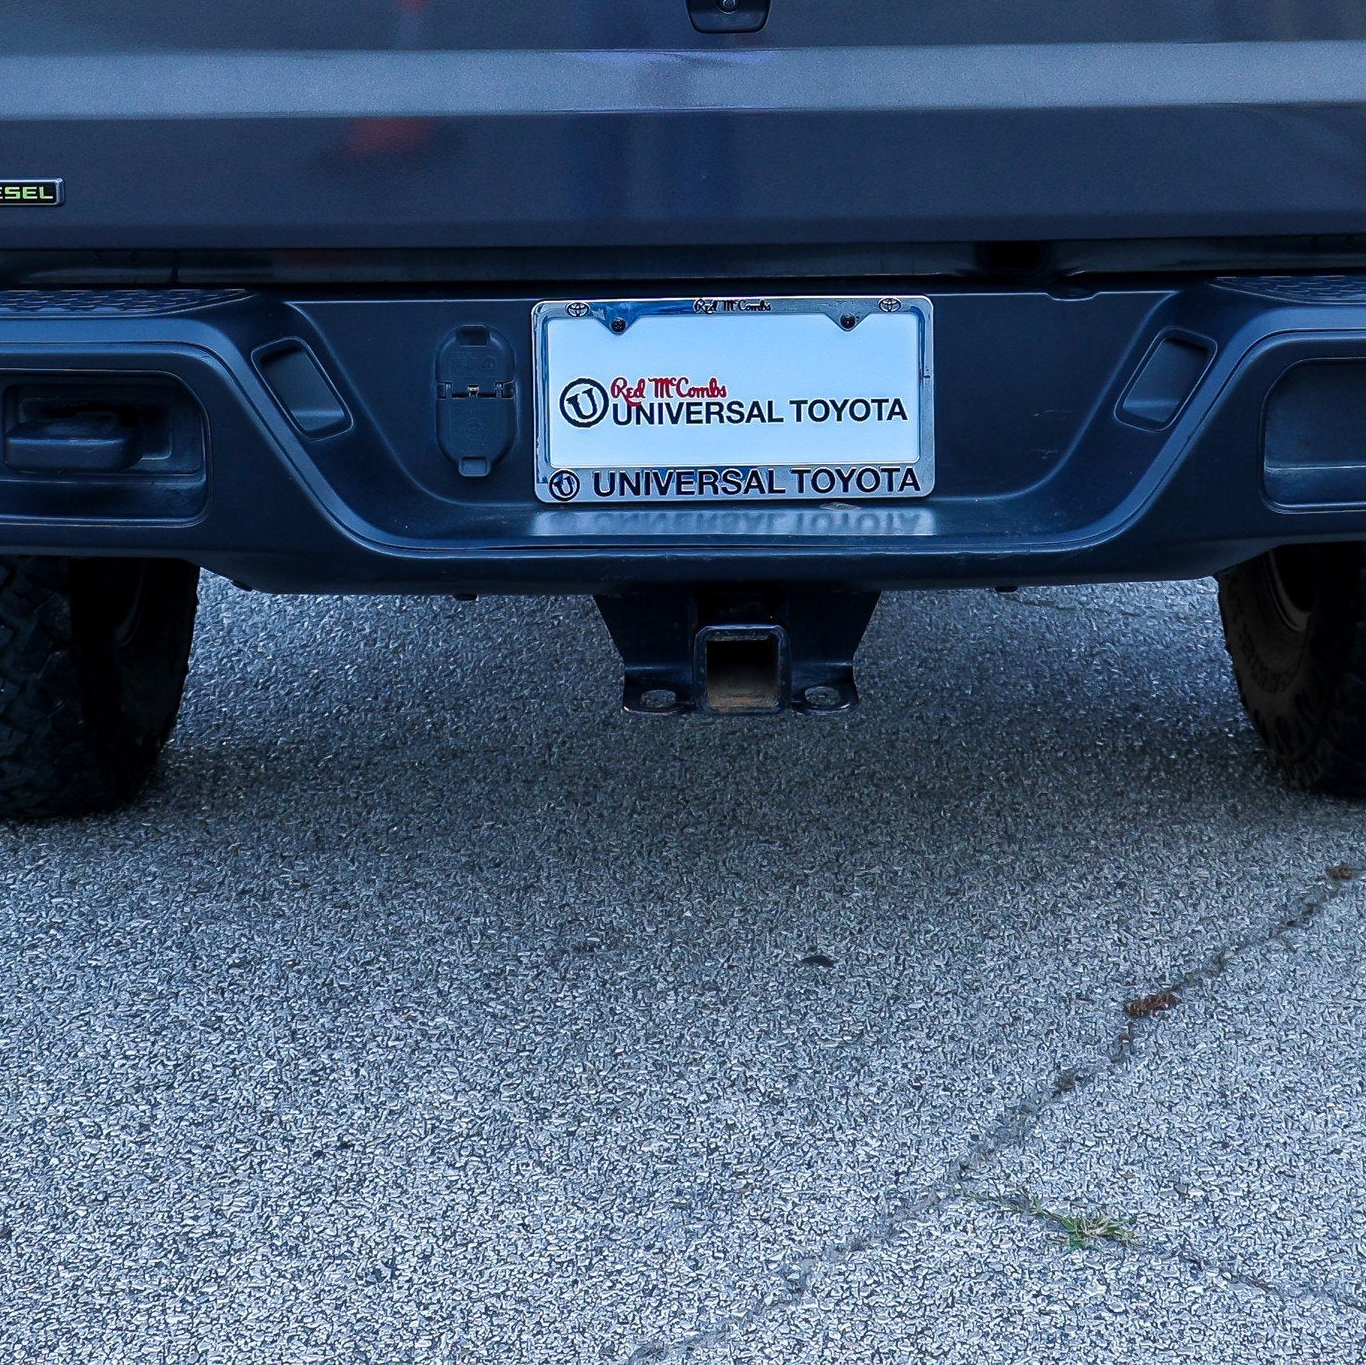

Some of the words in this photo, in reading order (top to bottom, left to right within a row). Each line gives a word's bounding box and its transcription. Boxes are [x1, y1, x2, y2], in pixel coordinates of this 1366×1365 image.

[694, 298, 717, 314] Red
[722, 298, 771, 312] McCombs
[610, 376, 646, 407] Red
[648, 376, 727, 399] McCombs
[611, 399, 784, 426] UNIVERSAL
[789, 397, 908, 423] TOYOTA
[592, 467, 786, 498] UNIVERSAL
[789, 466, 922, 495] TOYOTA
